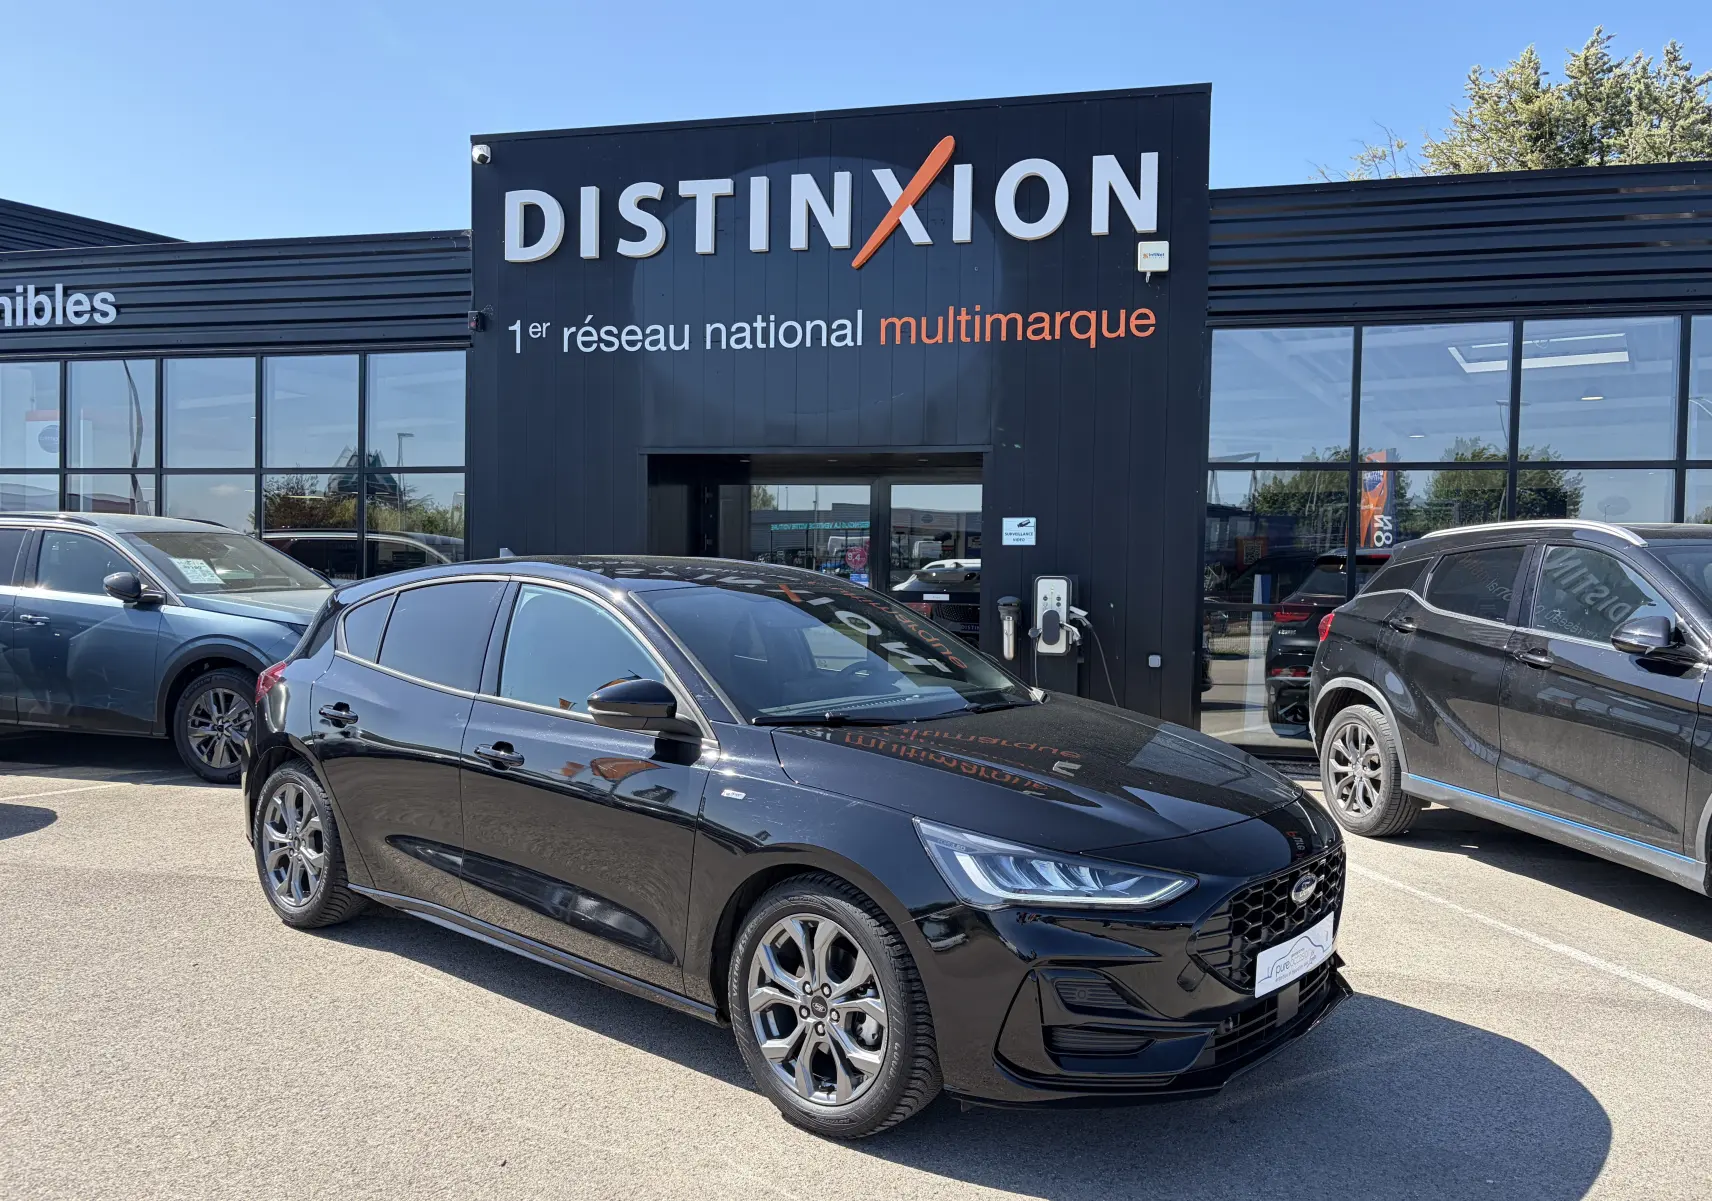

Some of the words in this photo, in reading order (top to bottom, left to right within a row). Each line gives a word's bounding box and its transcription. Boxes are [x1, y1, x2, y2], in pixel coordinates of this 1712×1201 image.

[504, 135, 1158, 268] DISTINXION
[508, 317, 550, 354] 1er
[563, 314, 690, 353] réseau
[705, 309, 863, 349] national
[880, 304, 1156, 349] multimarque
